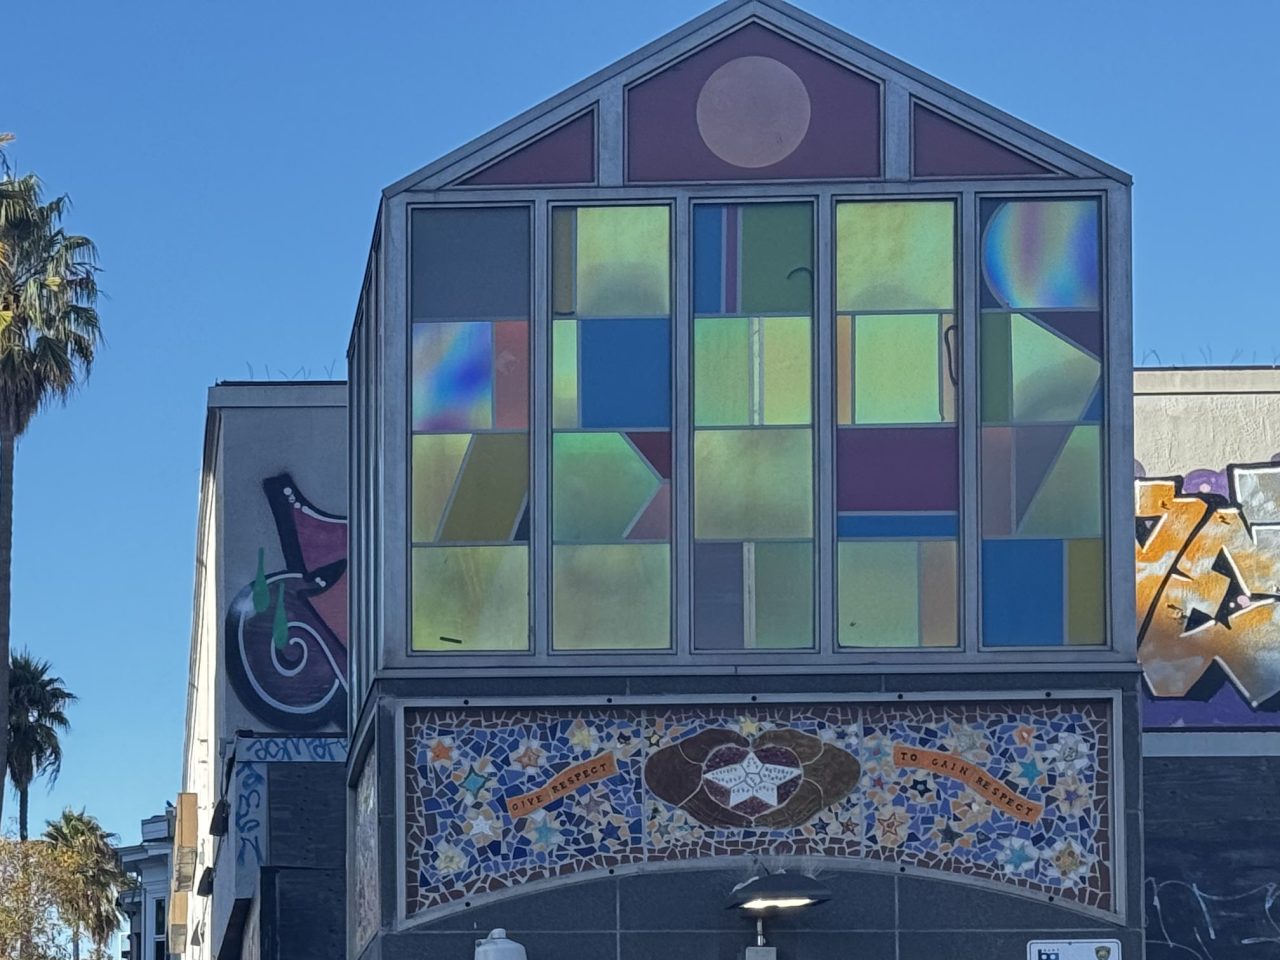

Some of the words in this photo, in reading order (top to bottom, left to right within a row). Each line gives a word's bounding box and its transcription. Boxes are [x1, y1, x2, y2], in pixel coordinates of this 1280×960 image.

[512, 795, 543, 811] GIVE
[551, 763, 608, 794] RESPECT
[900, 752, 918, 762] TO
[931, 757, 969, 776] GAIN
[975, 777, 1033, 816] RESPECT
